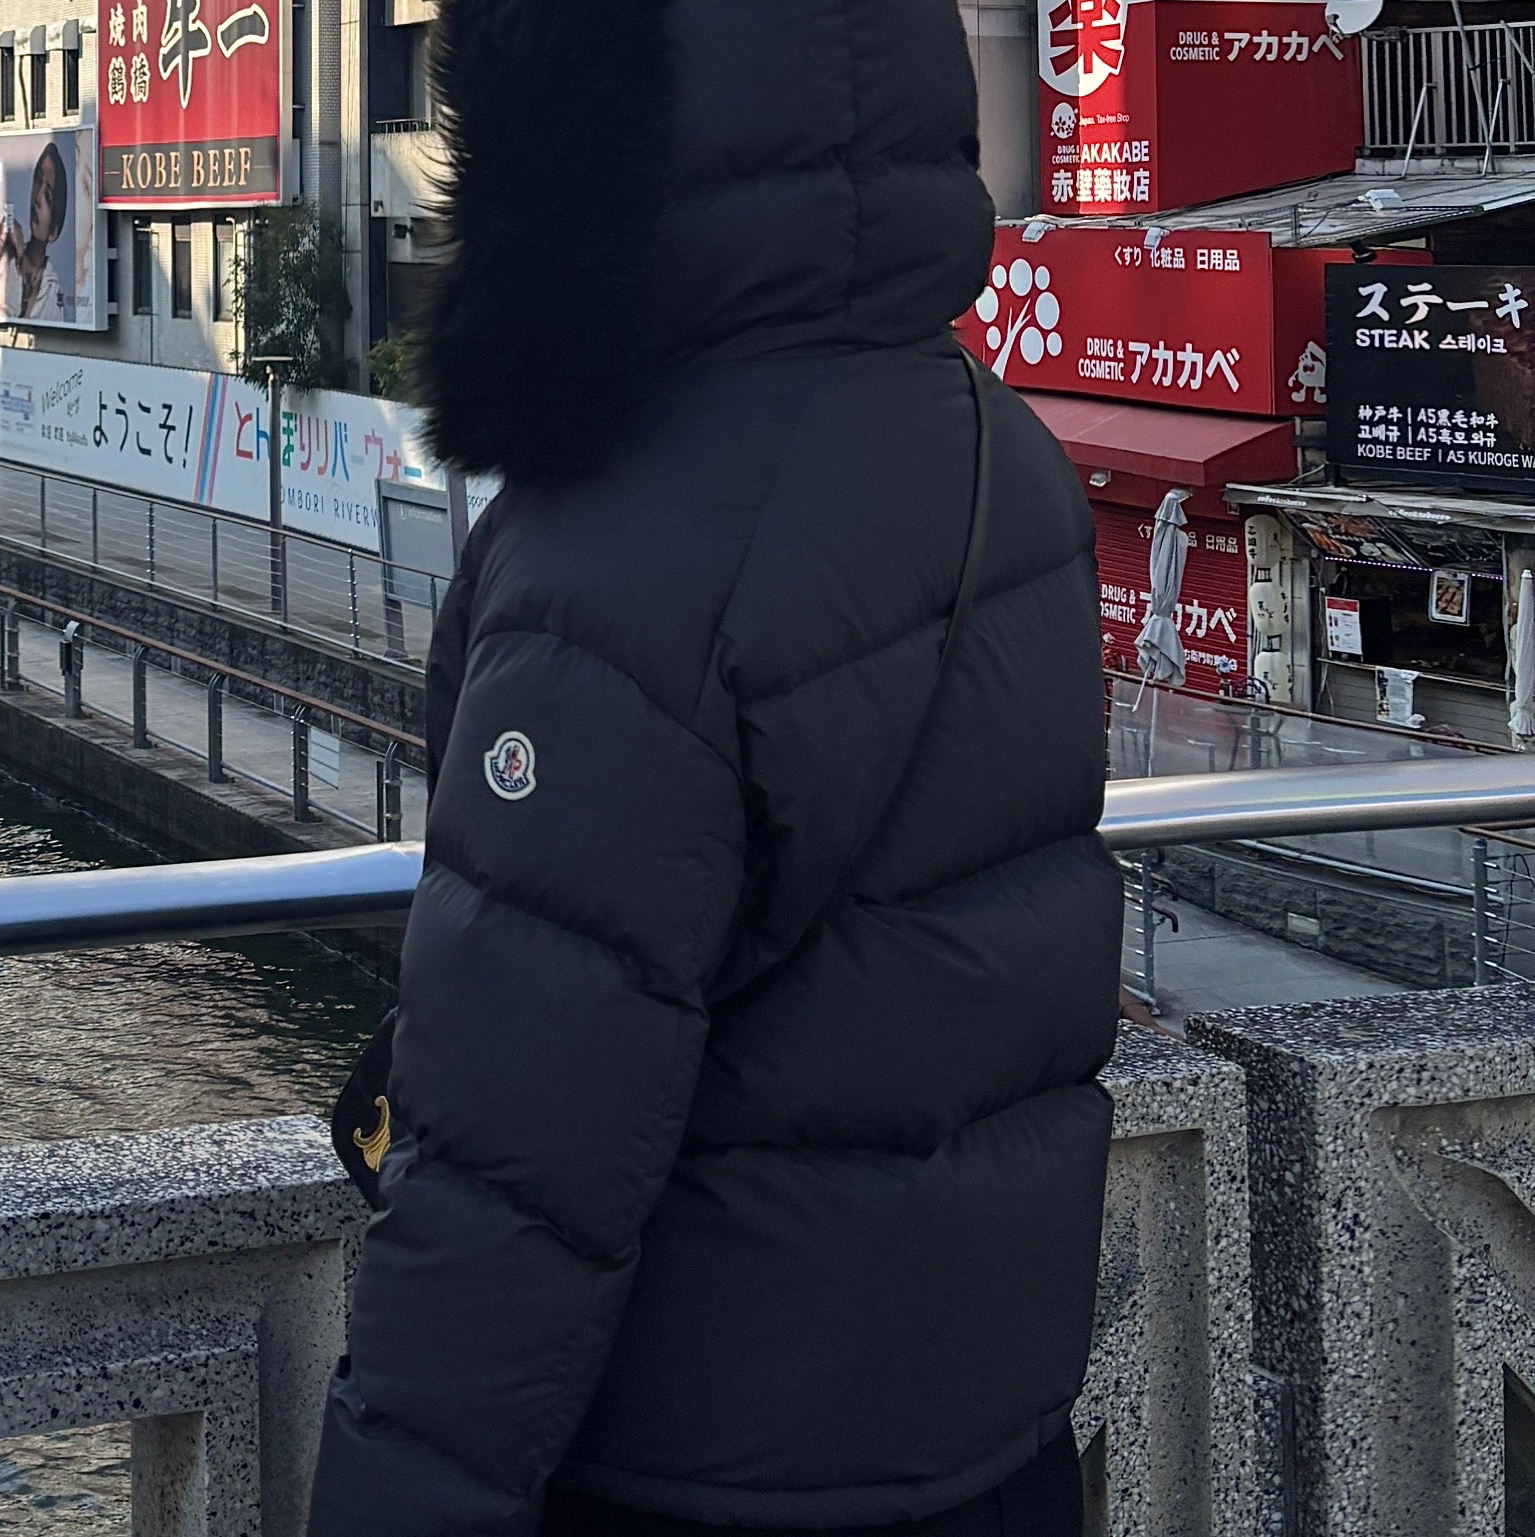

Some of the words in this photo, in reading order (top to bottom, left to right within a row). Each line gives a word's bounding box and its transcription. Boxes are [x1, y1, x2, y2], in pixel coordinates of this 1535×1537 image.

[1178, 31, 1209, 45] DRUG
[1211, 31, 1220, 45] &
[1169, 46, 1220, 61] COSMETIC
[107, 52, 151, 106] 鶴橋
[1117, 113, 1130, 124] Shop
[1081, 140, 1150, 163] AKAKABE
[121, 151, 182, 189] KOBE
[191, 146, 252, 188] BEEF
[1114, 245, 1142, 267] くすり
[1150, 247, 1186, 269] 化粧品
[1196, 249, 1241, 271] 日用品
[1355, 282, 1529, 329] ステーキ
[1087, 337, 1114, 357] DRUG
[1116, 340, 1124, 358] &
[1355, 329, 1431, 350] STEAK
[1438, 333, 1508, 354] 스테이크
[1078, 358, 1124, 381] COSMETIC
[1128, 340, 1240, 393] アカカベ
[42, 368, 84, 414] Welcome
[1358, 405, 1403, 422] 神戸牛
[1358, 425, 1401, 444] 고베규
[1357, 444, 1394, 460] KOBE
[1396, 446, 1432, 462] BEEF
[1446, 450, 1466, 463] A5
[1468, 451, 1520, 468] KUROGE
[1521, 454, 1535, 469] W
[1206, 535, 1239, 555] 日用品
[1101, 583, 1127, 602] DRUG
[1129, 589, 1136, 605] &
